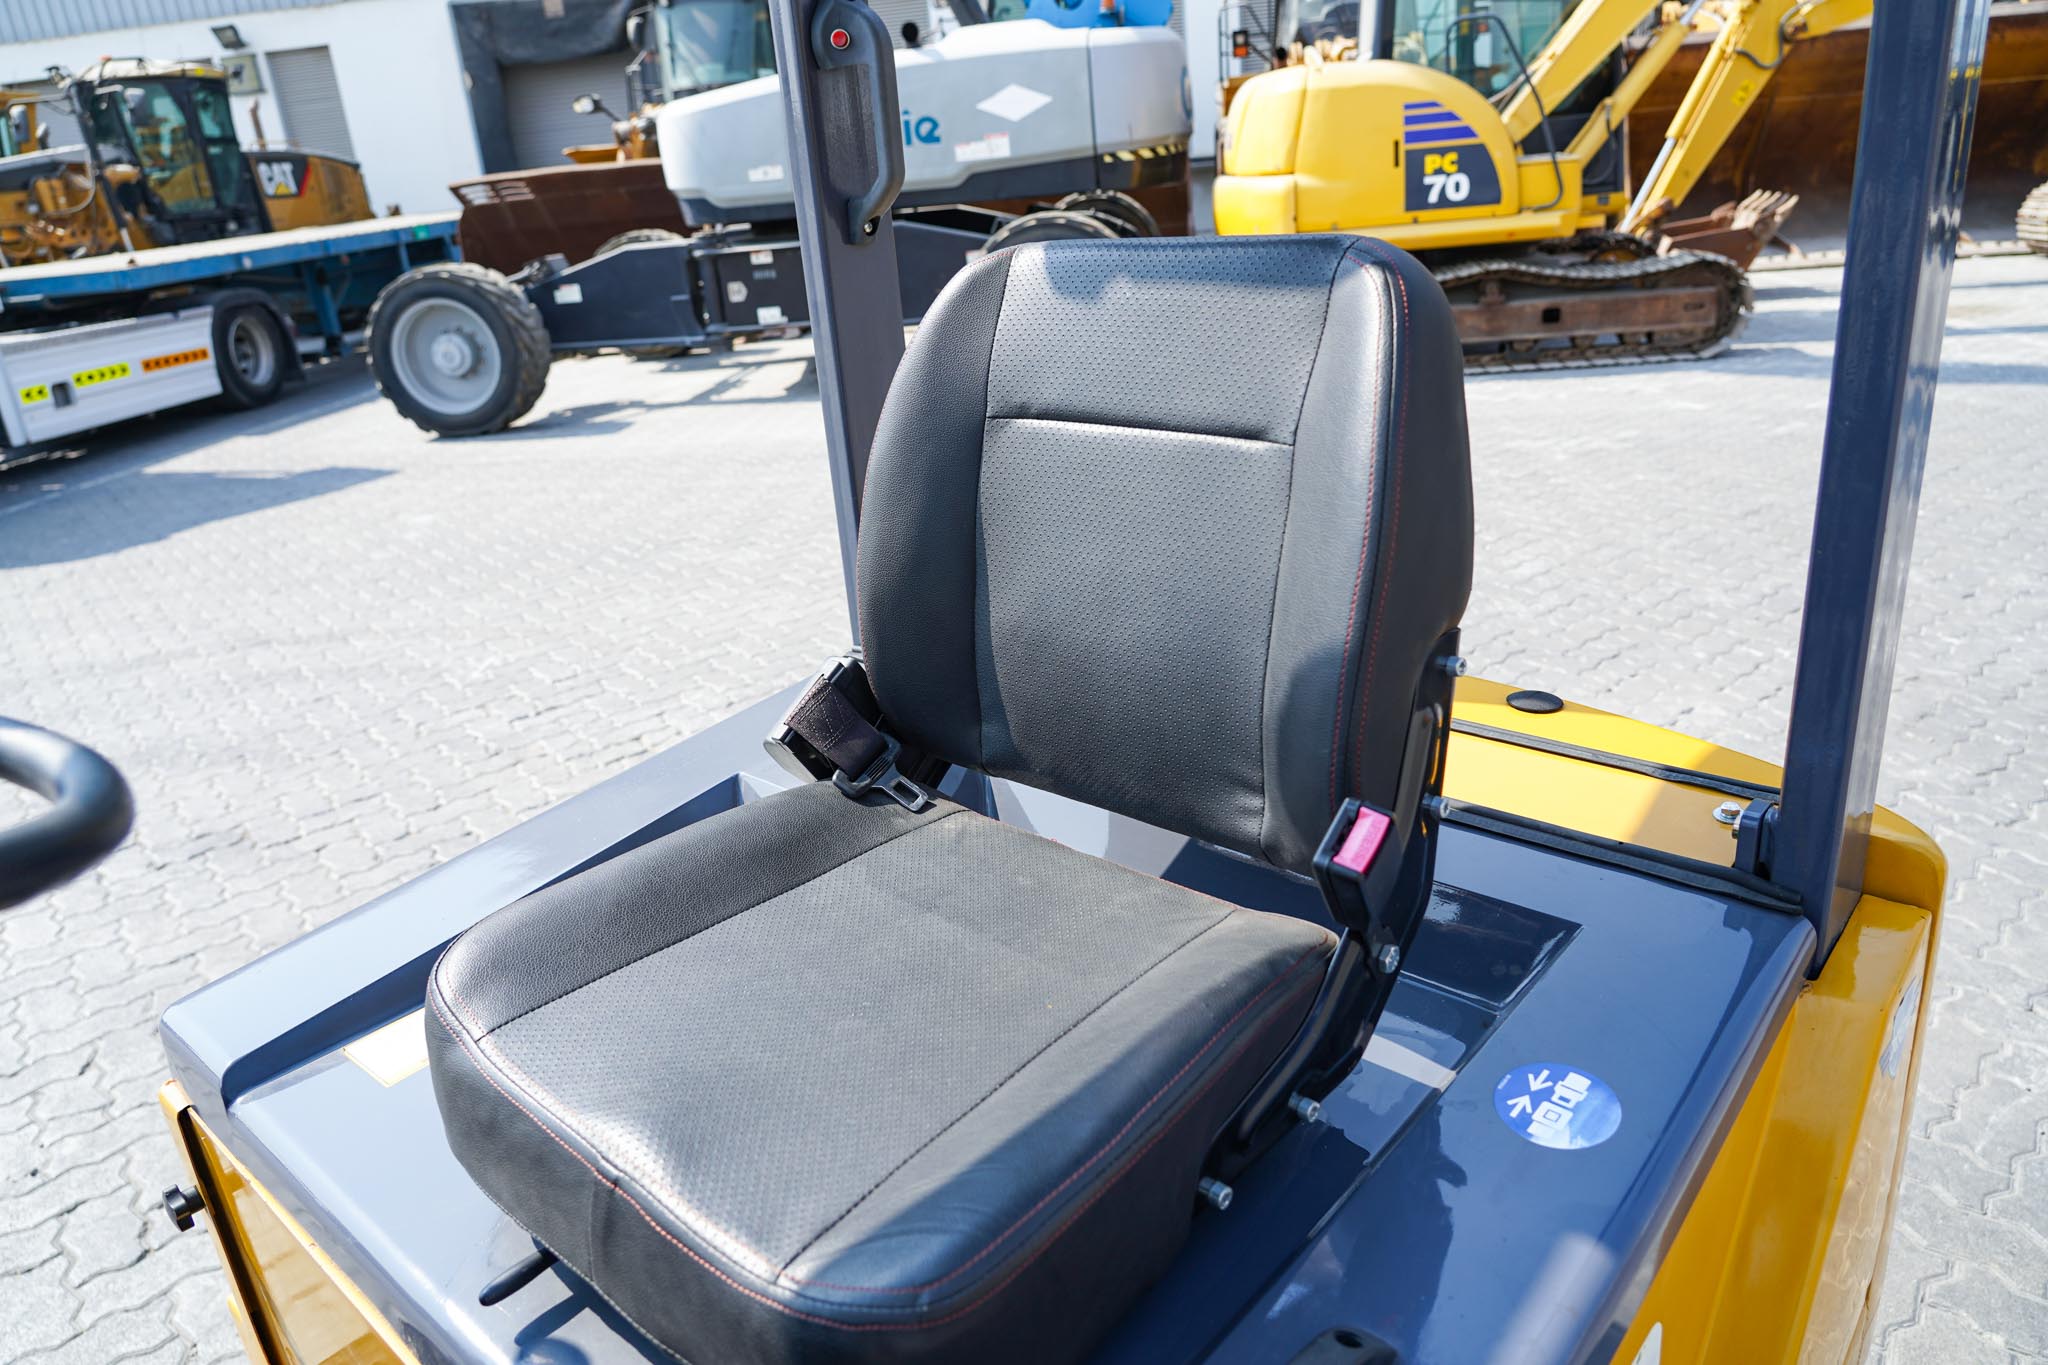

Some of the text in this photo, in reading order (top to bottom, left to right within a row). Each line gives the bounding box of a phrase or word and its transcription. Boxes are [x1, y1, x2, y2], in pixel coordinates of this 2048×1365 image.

[902, 109, 941, 146] ie
[257, 161, 299, 196] CAT
[1423, 151, 1459, 175] PC
[1422, 171, 1471, 205] 70
